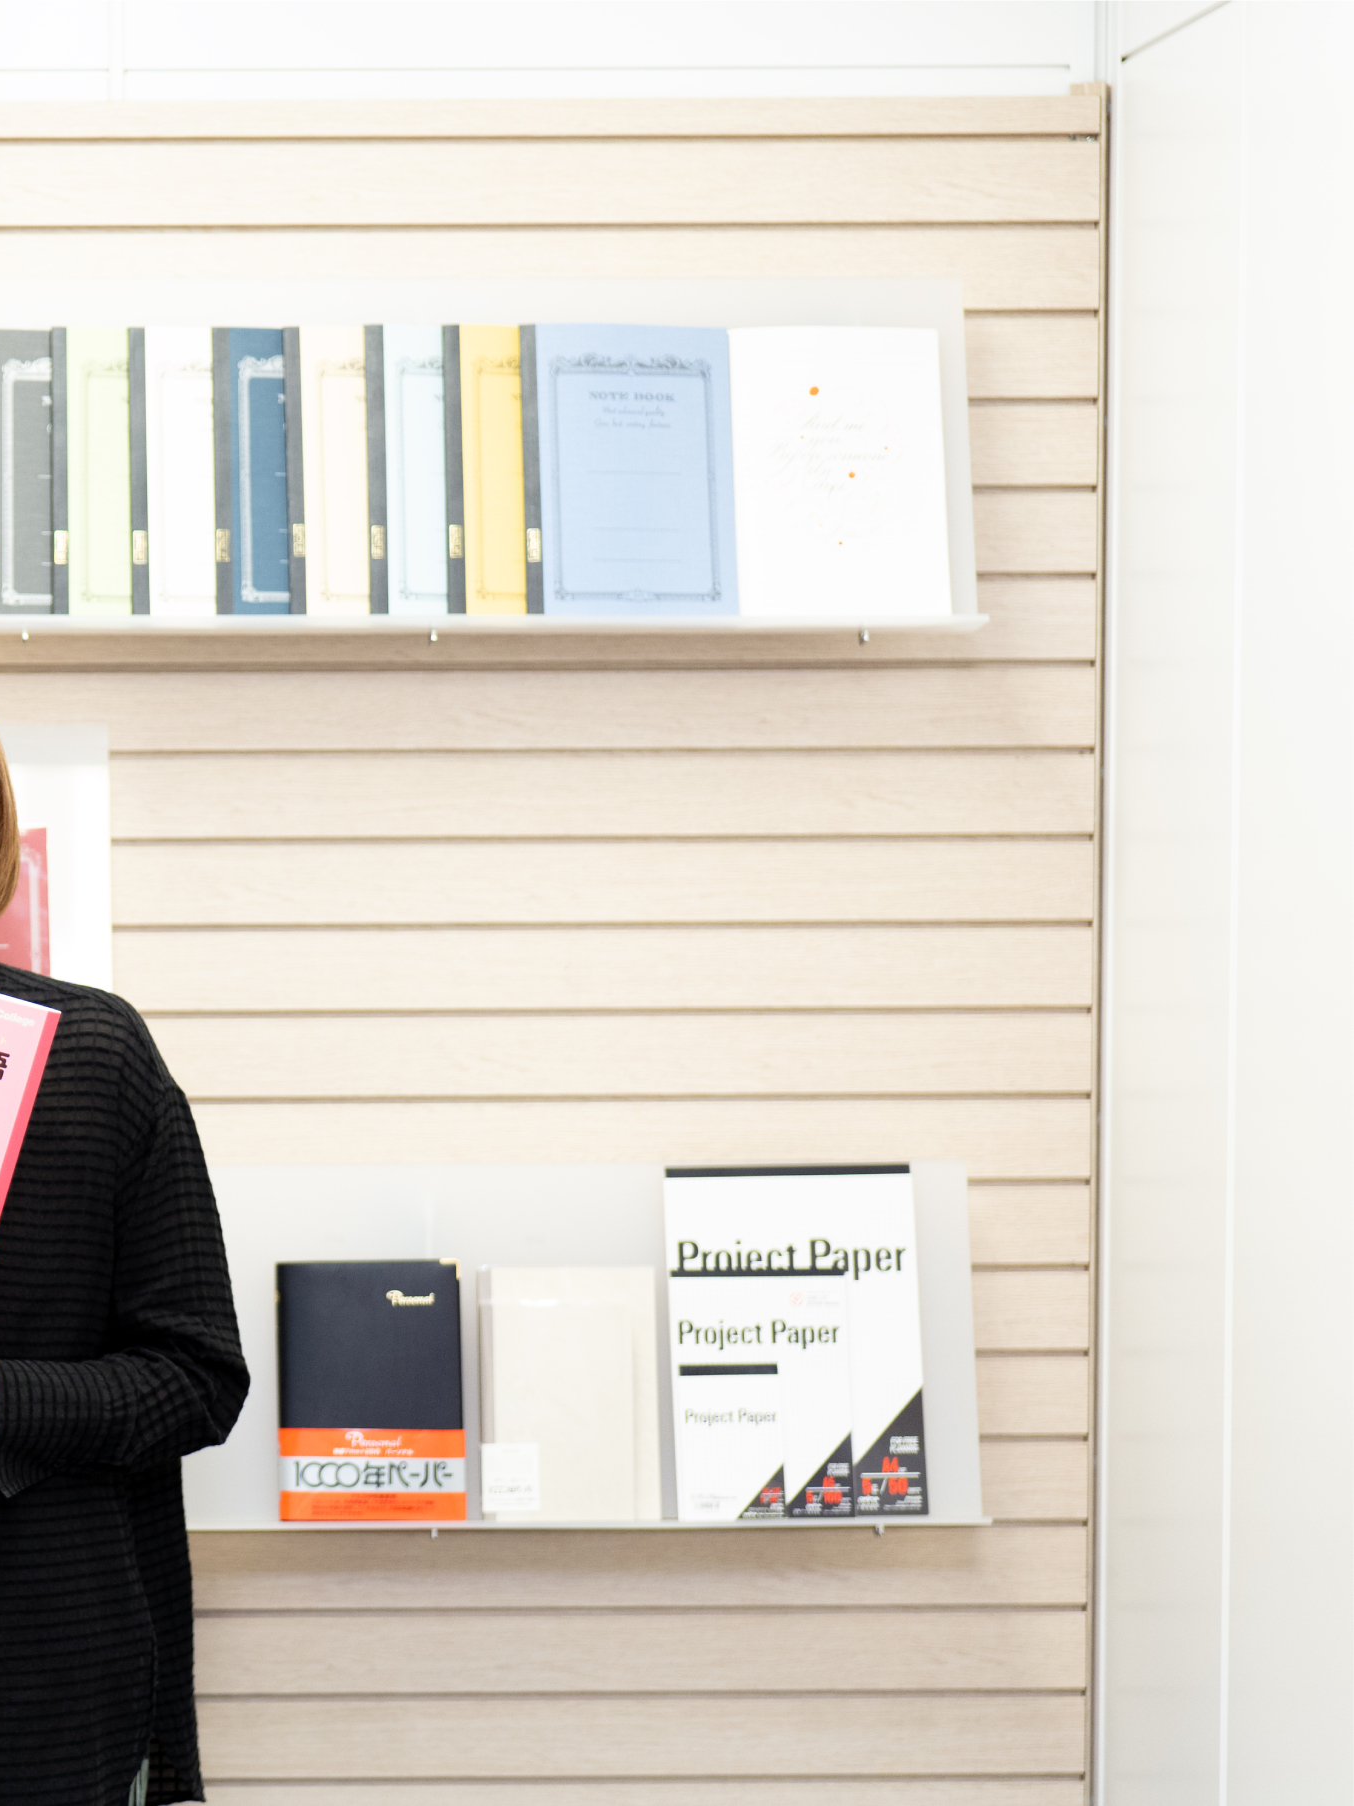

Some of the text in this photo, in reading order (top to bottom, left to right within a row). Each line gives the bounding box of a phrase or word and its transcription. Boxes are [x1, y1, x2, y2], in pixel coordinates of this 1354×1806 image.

[589, 391, 675, 402] NOTE BOOK
[676, 1238, 907, 1281] Project Paper
[677, 1318, 840, 1351] Project Paper
[684, 1409, 778, 1426] Project Paper
[344, 1430, 402, 1448] Personal
[294, 1460, 453, 1489] 1000年ペーパー
